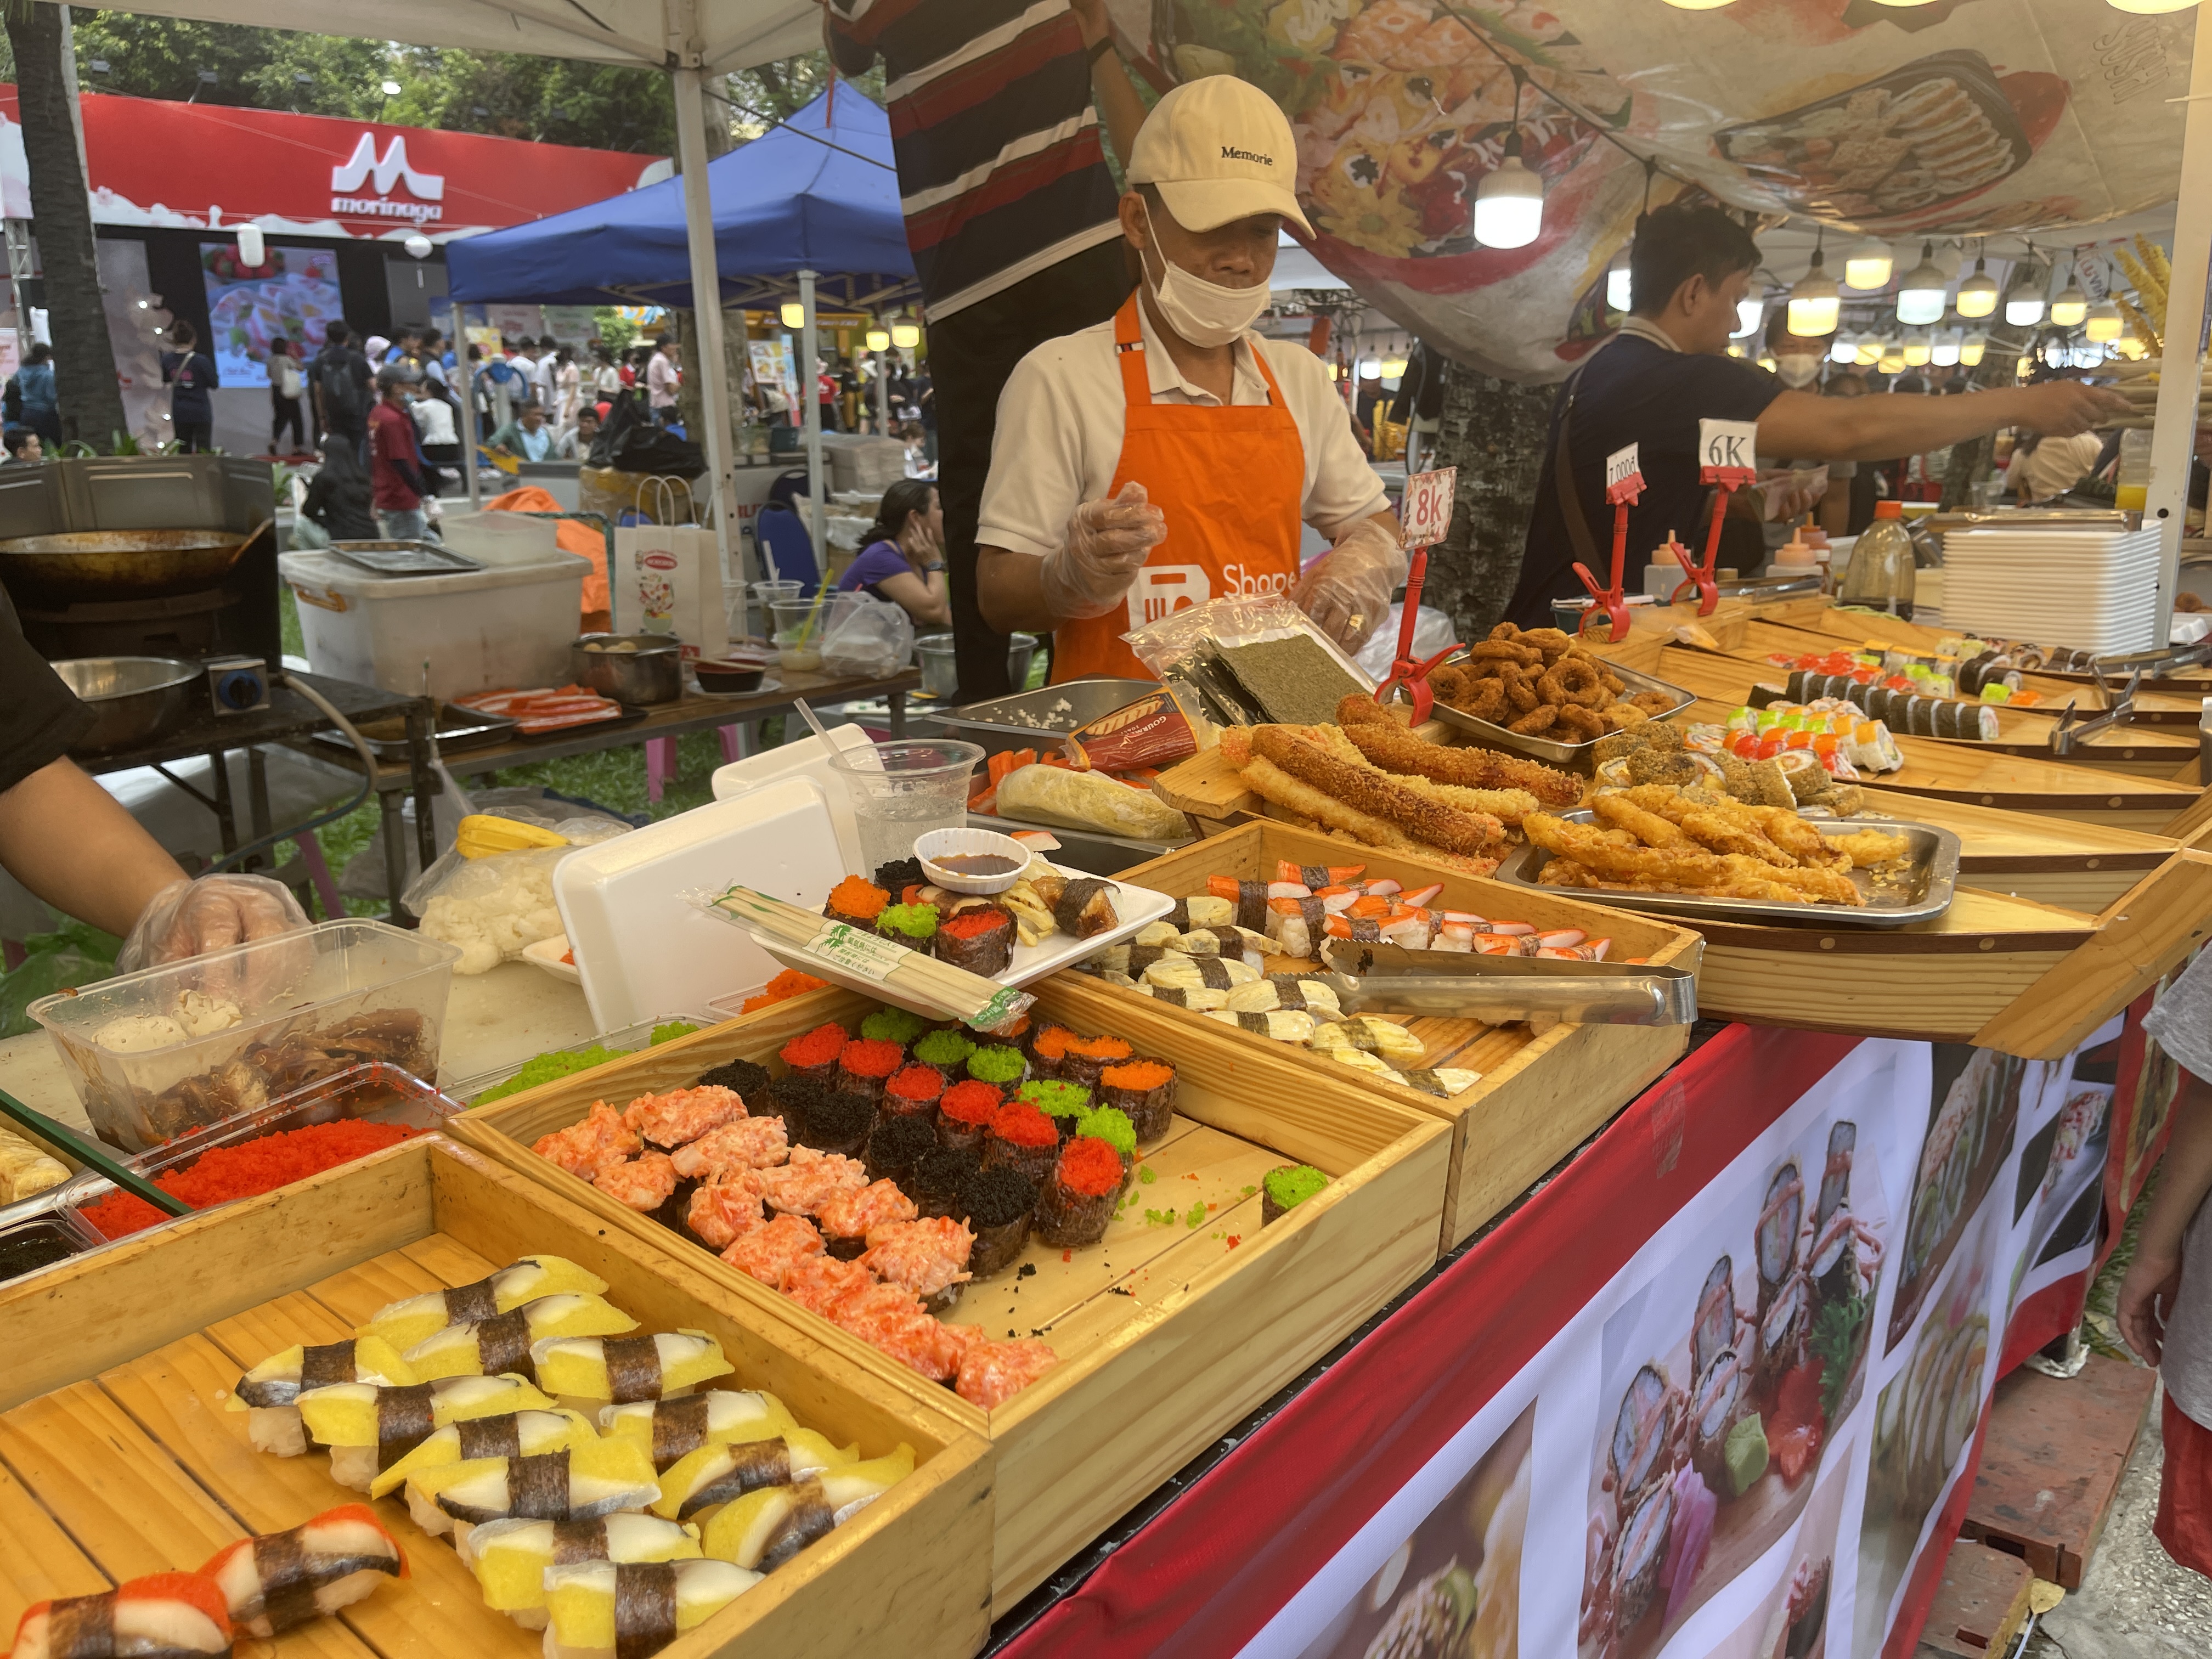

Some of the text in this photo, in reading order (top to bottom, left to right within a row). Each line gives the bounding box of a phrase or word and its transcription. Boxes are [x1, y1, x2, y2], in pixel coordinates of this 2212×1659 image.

[1221, 146, 1273, 166] Memorie
[331, 196, 443, 224] morinaga
[1709, 435, 1747, 467] 6K
